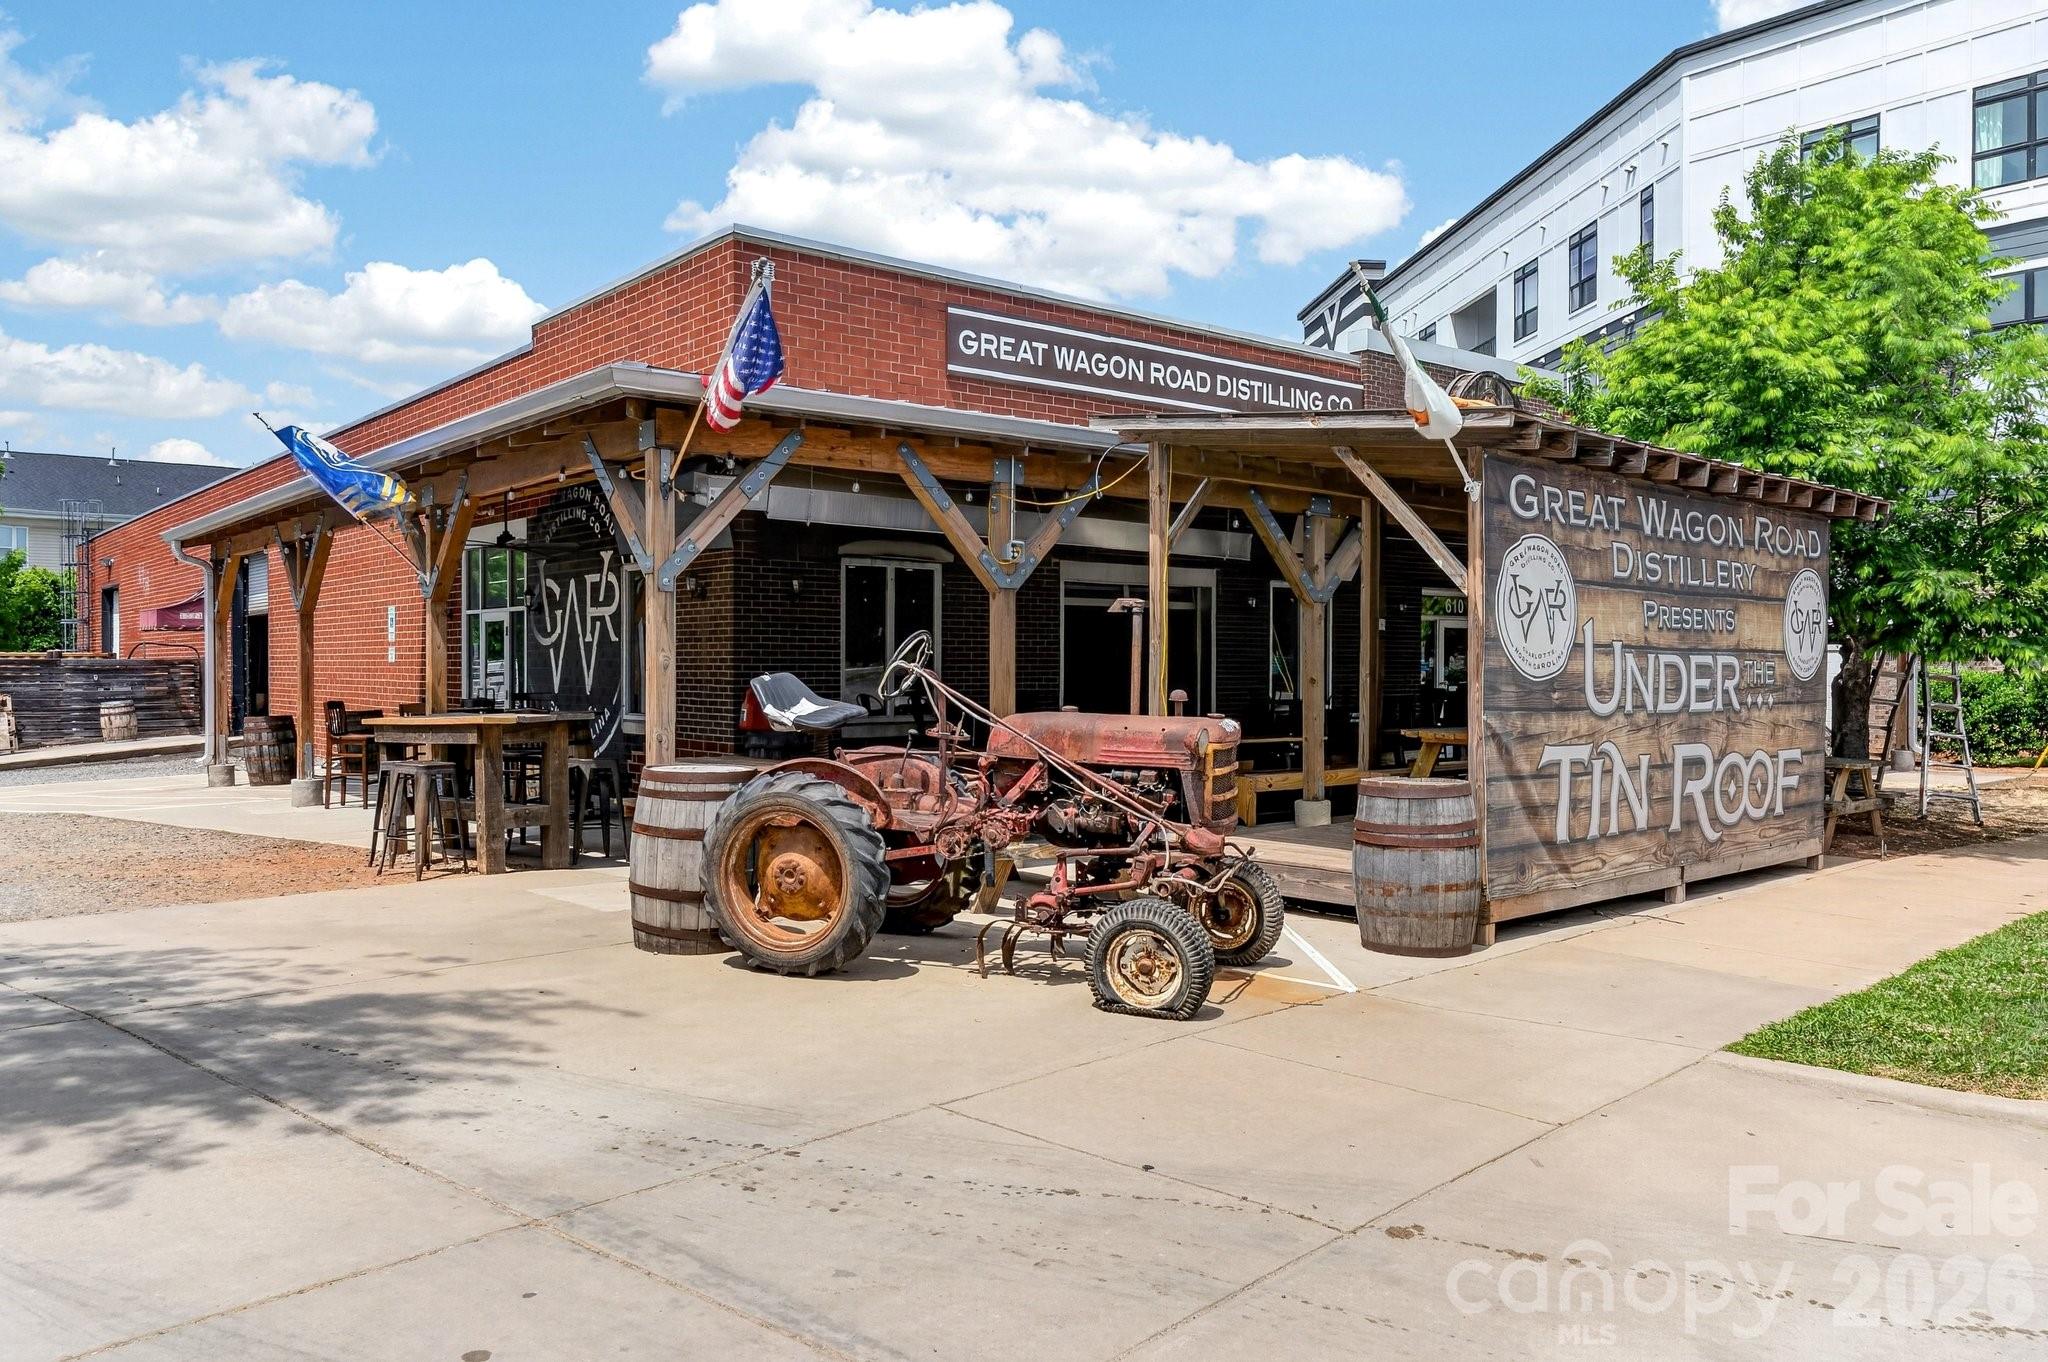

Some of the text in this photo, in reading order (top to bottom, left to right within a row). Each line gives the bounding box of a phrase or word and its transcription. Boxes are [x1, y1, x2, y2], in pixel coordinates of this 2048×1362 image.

[958, 329, 1049, 365] GREAT
[1053, 345, 1145, 382] WAGON
[1150, 362, 1211, 394] ROAD
[1216, 375, 1323, 411] DISTILLING
[1509, 474, 1822, 559] GREAT WAGON ROAD
[1611, 542, 1756, 591] DISTILLERY
[1445, 599, 1464, 613] 610
[1643, 602, 1736, 632] PRESENTS
[1582, 618, 1741, 717] UNDER
[1745, 659, 1775, 687] THE
[1536, 740, 1803, 844] TIN ROOF
